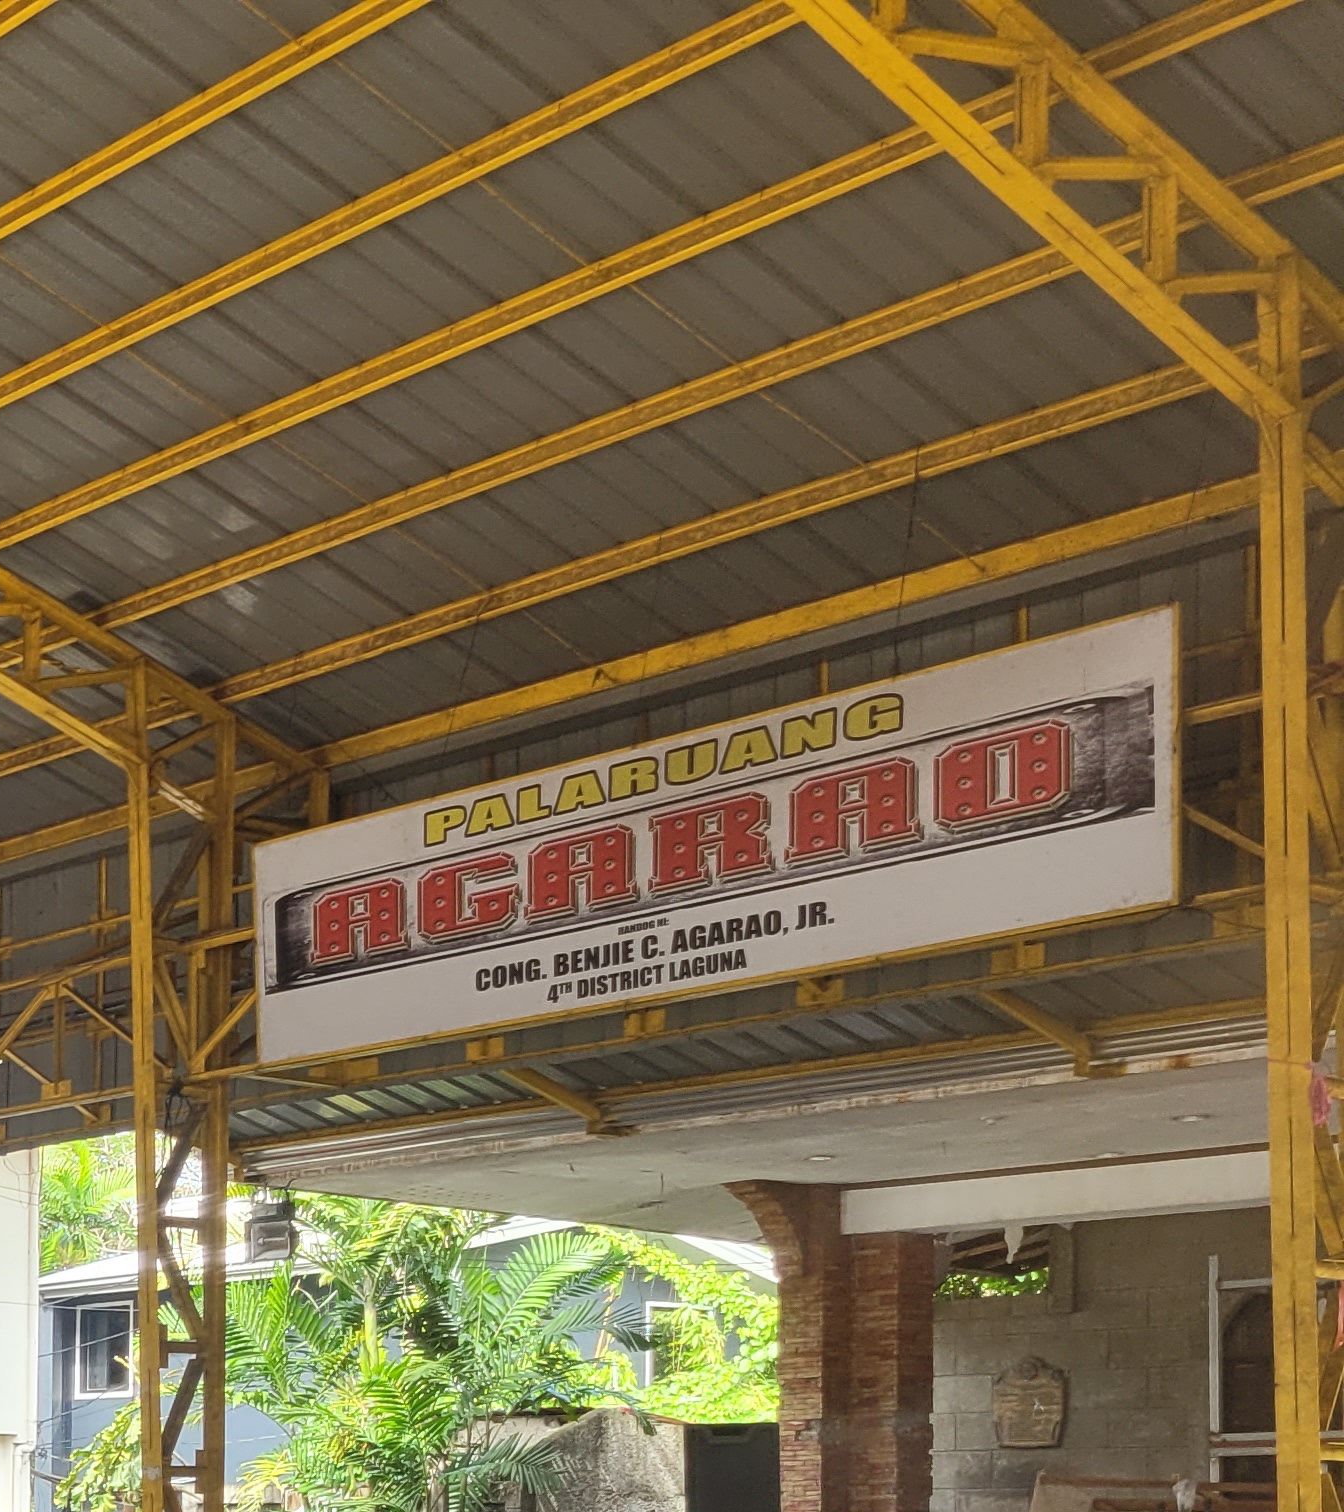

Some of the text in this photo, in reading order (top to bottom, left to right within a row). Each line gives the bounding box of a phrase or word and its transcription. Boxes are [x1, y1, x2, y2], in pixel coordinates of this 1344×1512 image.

[423, 693, 906, 848] PALARUANG
[310, 719, 1079, 968] AGARAO
[475, 900, 835, 992] CONG. BENJIE C. AGARAO, JR.
[618, 918, 656, 935] HANDOG
[546, 948, 748, 1004] 4TH DISTRICT LAGUNA
